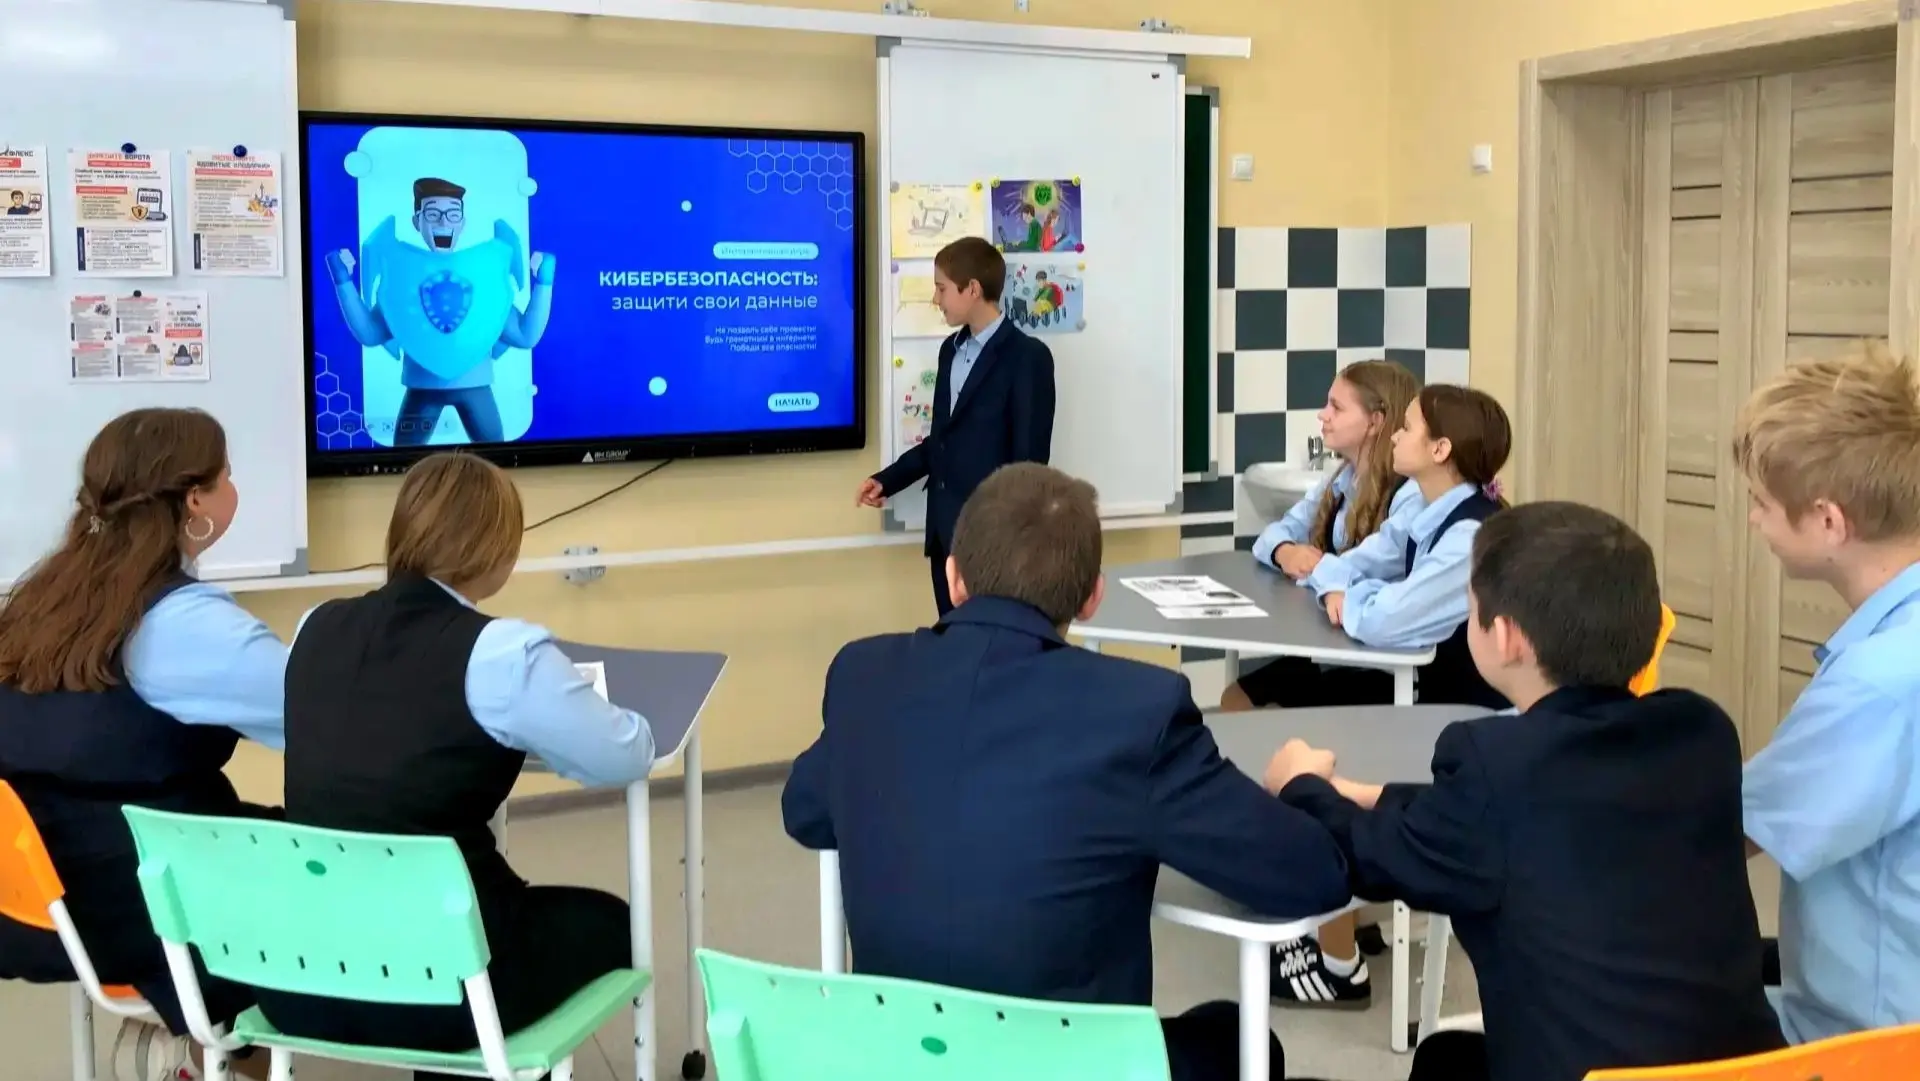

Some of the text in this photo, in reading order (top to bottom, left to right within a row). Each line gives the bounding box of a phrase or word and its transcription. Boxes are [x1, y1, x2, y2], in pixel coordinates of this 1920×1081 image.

[599, 270, 819, 287] КИБЕРБЕЗОПАСНОСТЬ:
[611, 294, 818, 311] защити свои данные
[775, 397, 812, 407] НАЧАТЬ
